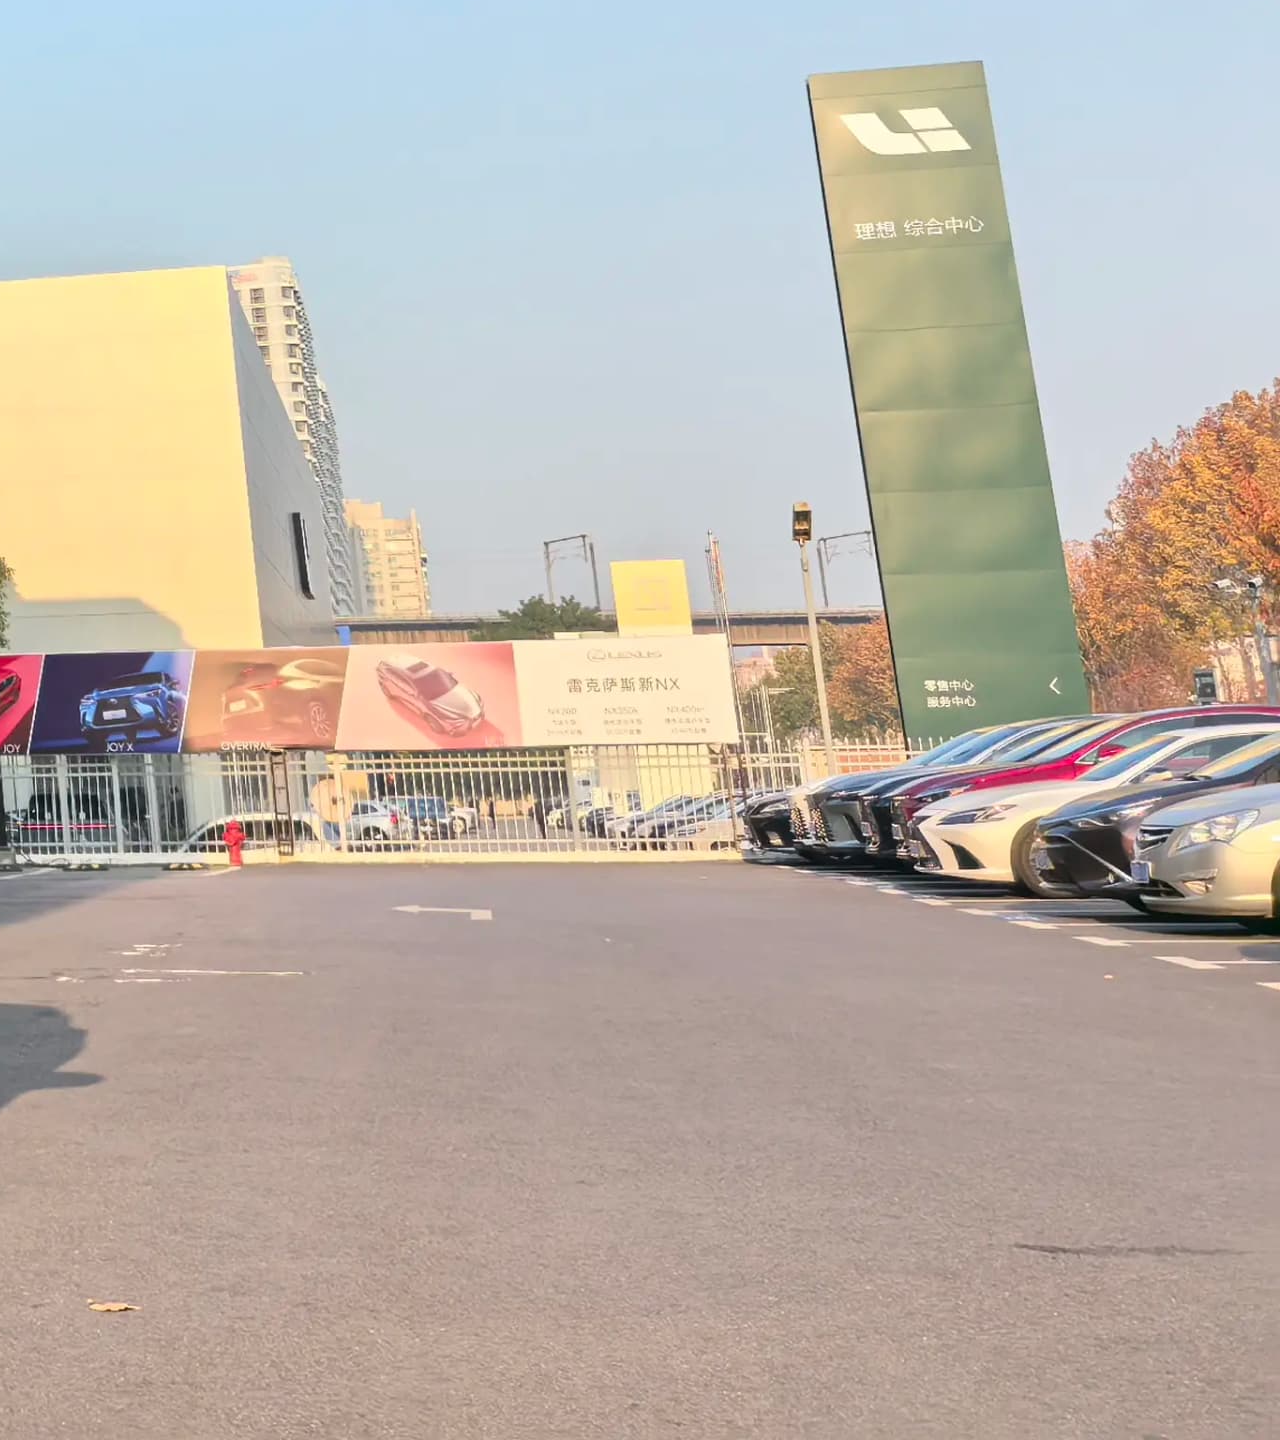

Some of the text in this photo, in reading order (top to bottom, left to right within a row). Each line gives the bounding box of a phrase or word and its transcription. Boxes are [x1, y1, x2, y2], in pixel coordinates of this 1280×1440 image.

[853, 215, 985, 241] 理想 综合中心
[566, 677, 680, 693] 雷克萨斯新NX
[2, 743, 21, 753] JOY
[106, 742, 125, 753] JOY
